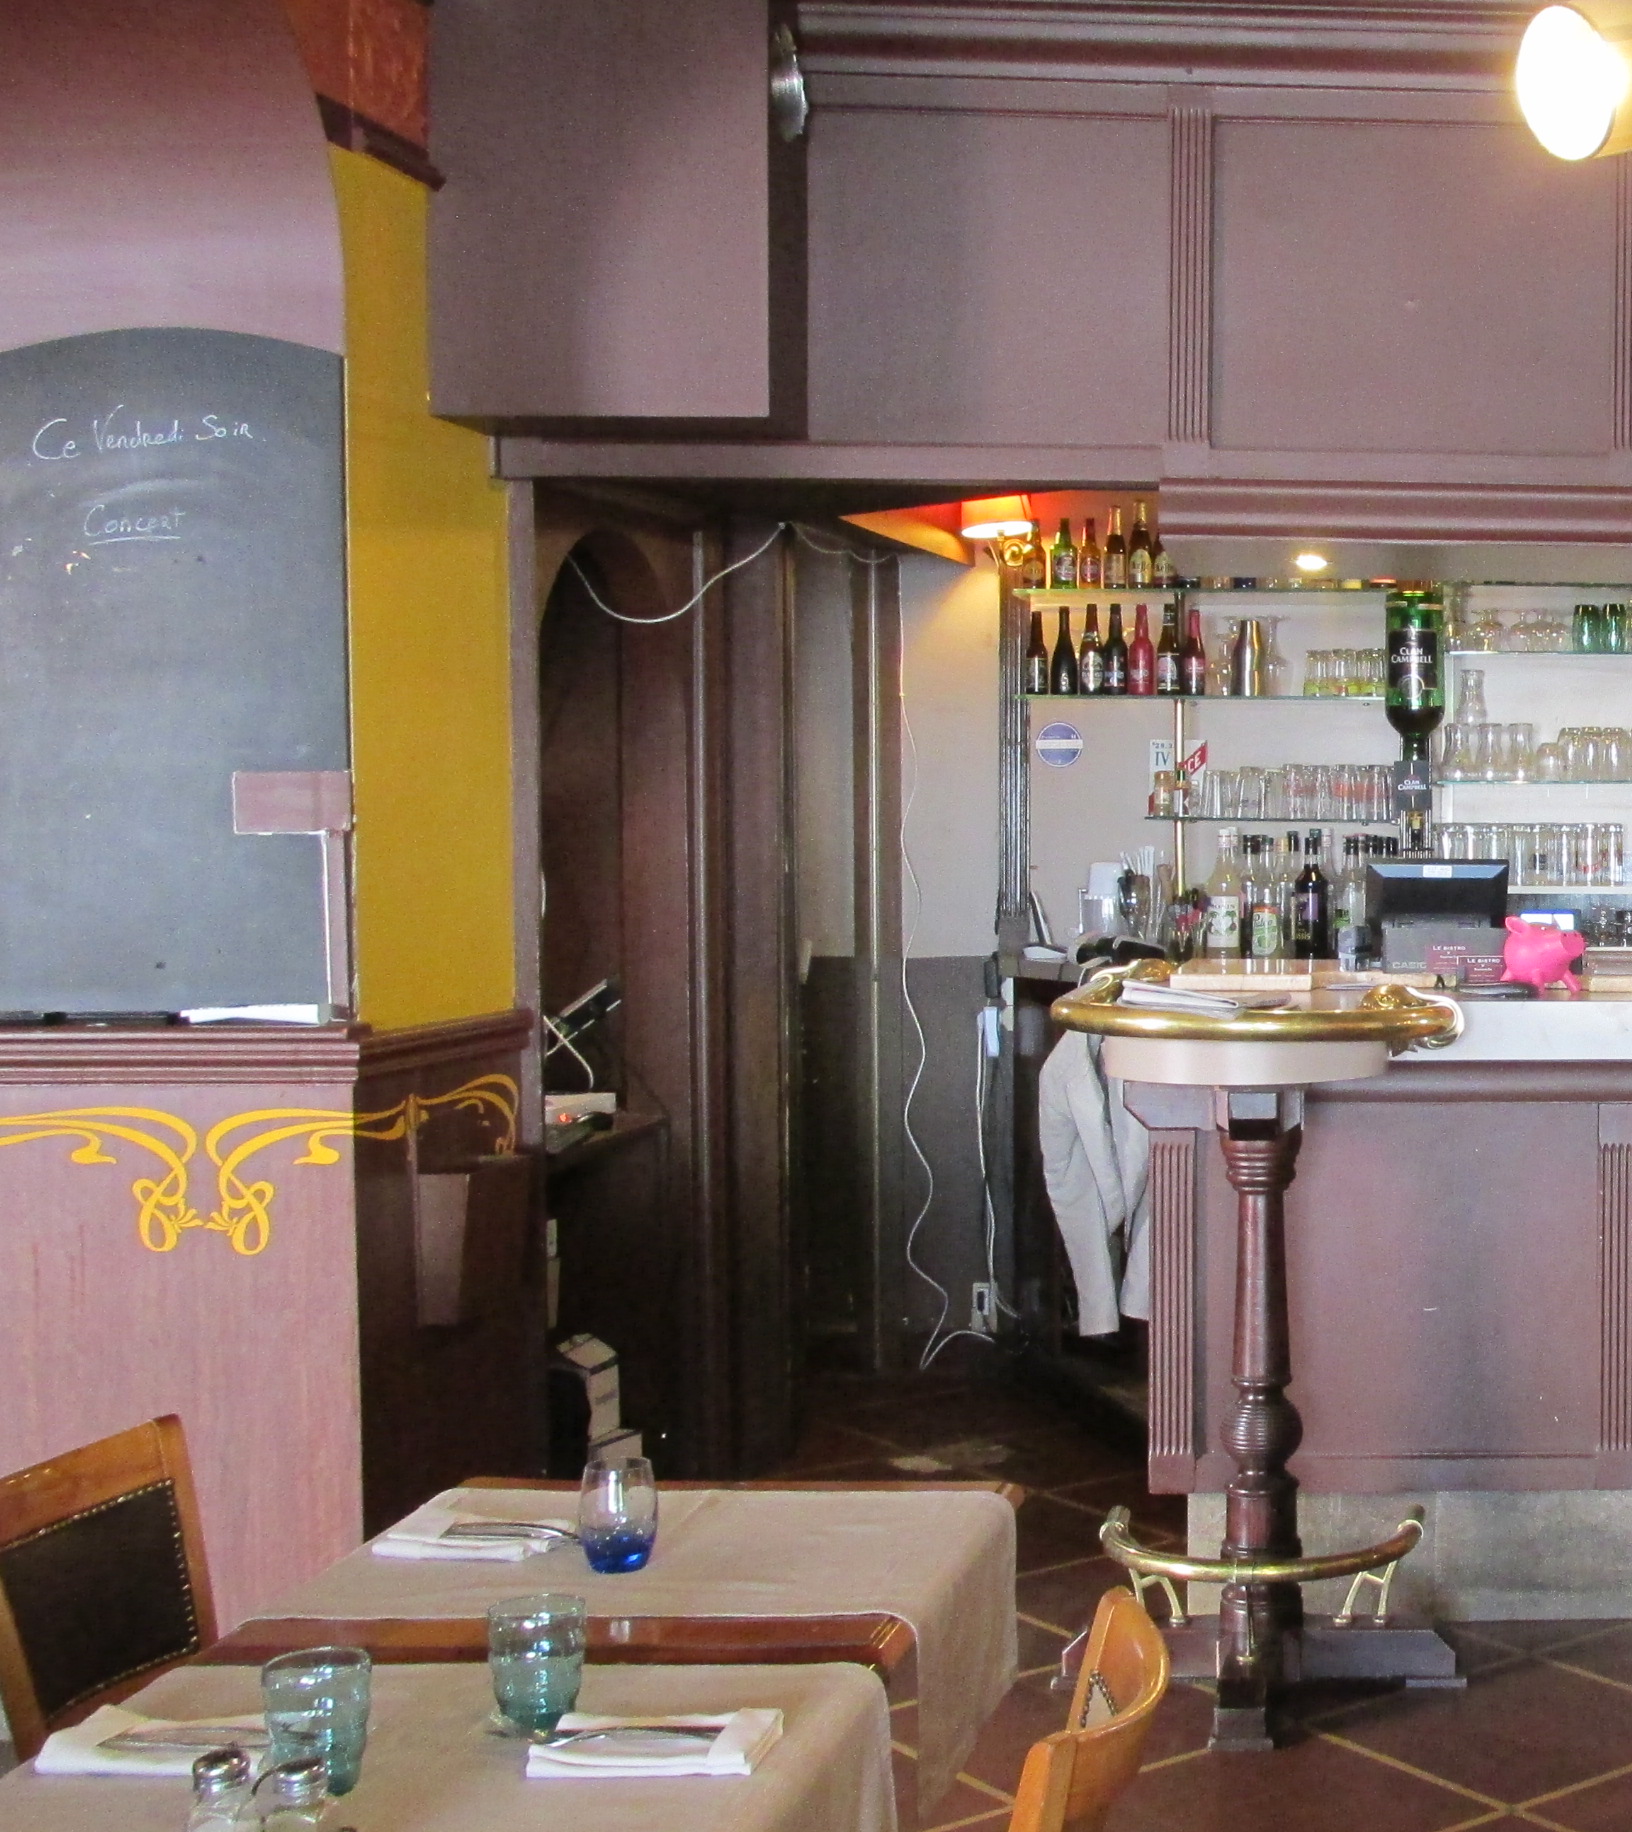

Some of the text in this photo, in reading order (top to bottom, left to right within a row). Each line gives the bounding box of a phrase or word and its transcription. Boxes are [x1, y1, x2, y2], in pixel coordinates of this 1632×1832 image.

[32, 417, 81, 460] Ce
[83, 504, 187, 537] Concert
[1155, 751, 1171, 766] IV
